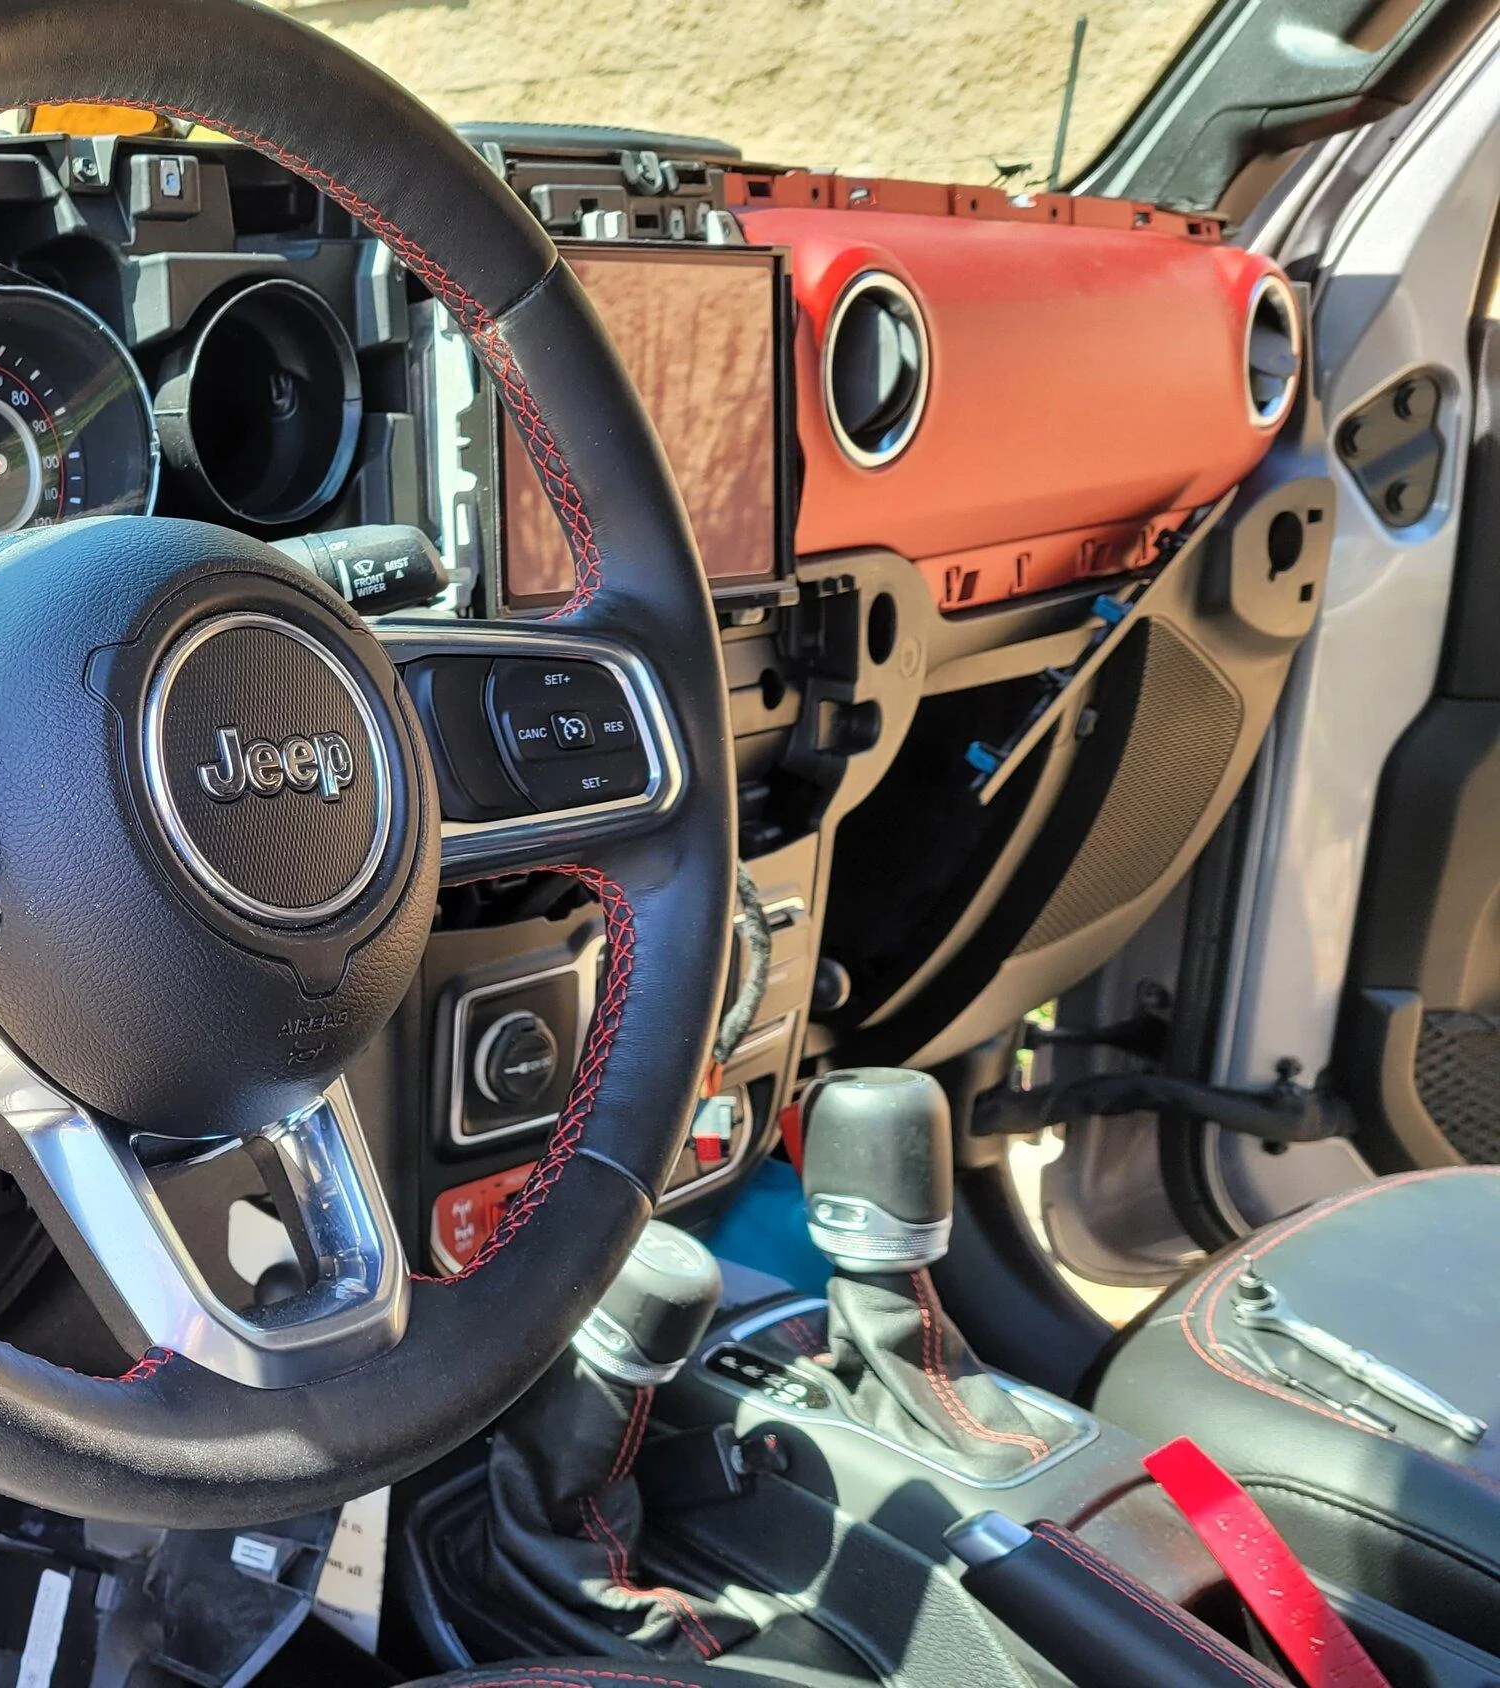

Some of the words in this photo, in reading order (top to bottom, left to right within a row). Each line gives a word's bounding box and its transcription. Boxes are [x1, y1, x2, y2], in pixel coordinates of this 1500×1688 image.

[11, 390, 29, 406] 80
[32, 420, 47, 433] 90
[41, 455, 60, 469] 100
[44, 486, 59, 501] 110
[384, 556, 410, 572] MIST
[353, 571, 385, 589] FRONT
[355, 582, 387, 598] WIPER
[518, 727, 548, 740] CANC
[603, 721, 625, 733] RES
[197, 726, 354, 802] Jeep
